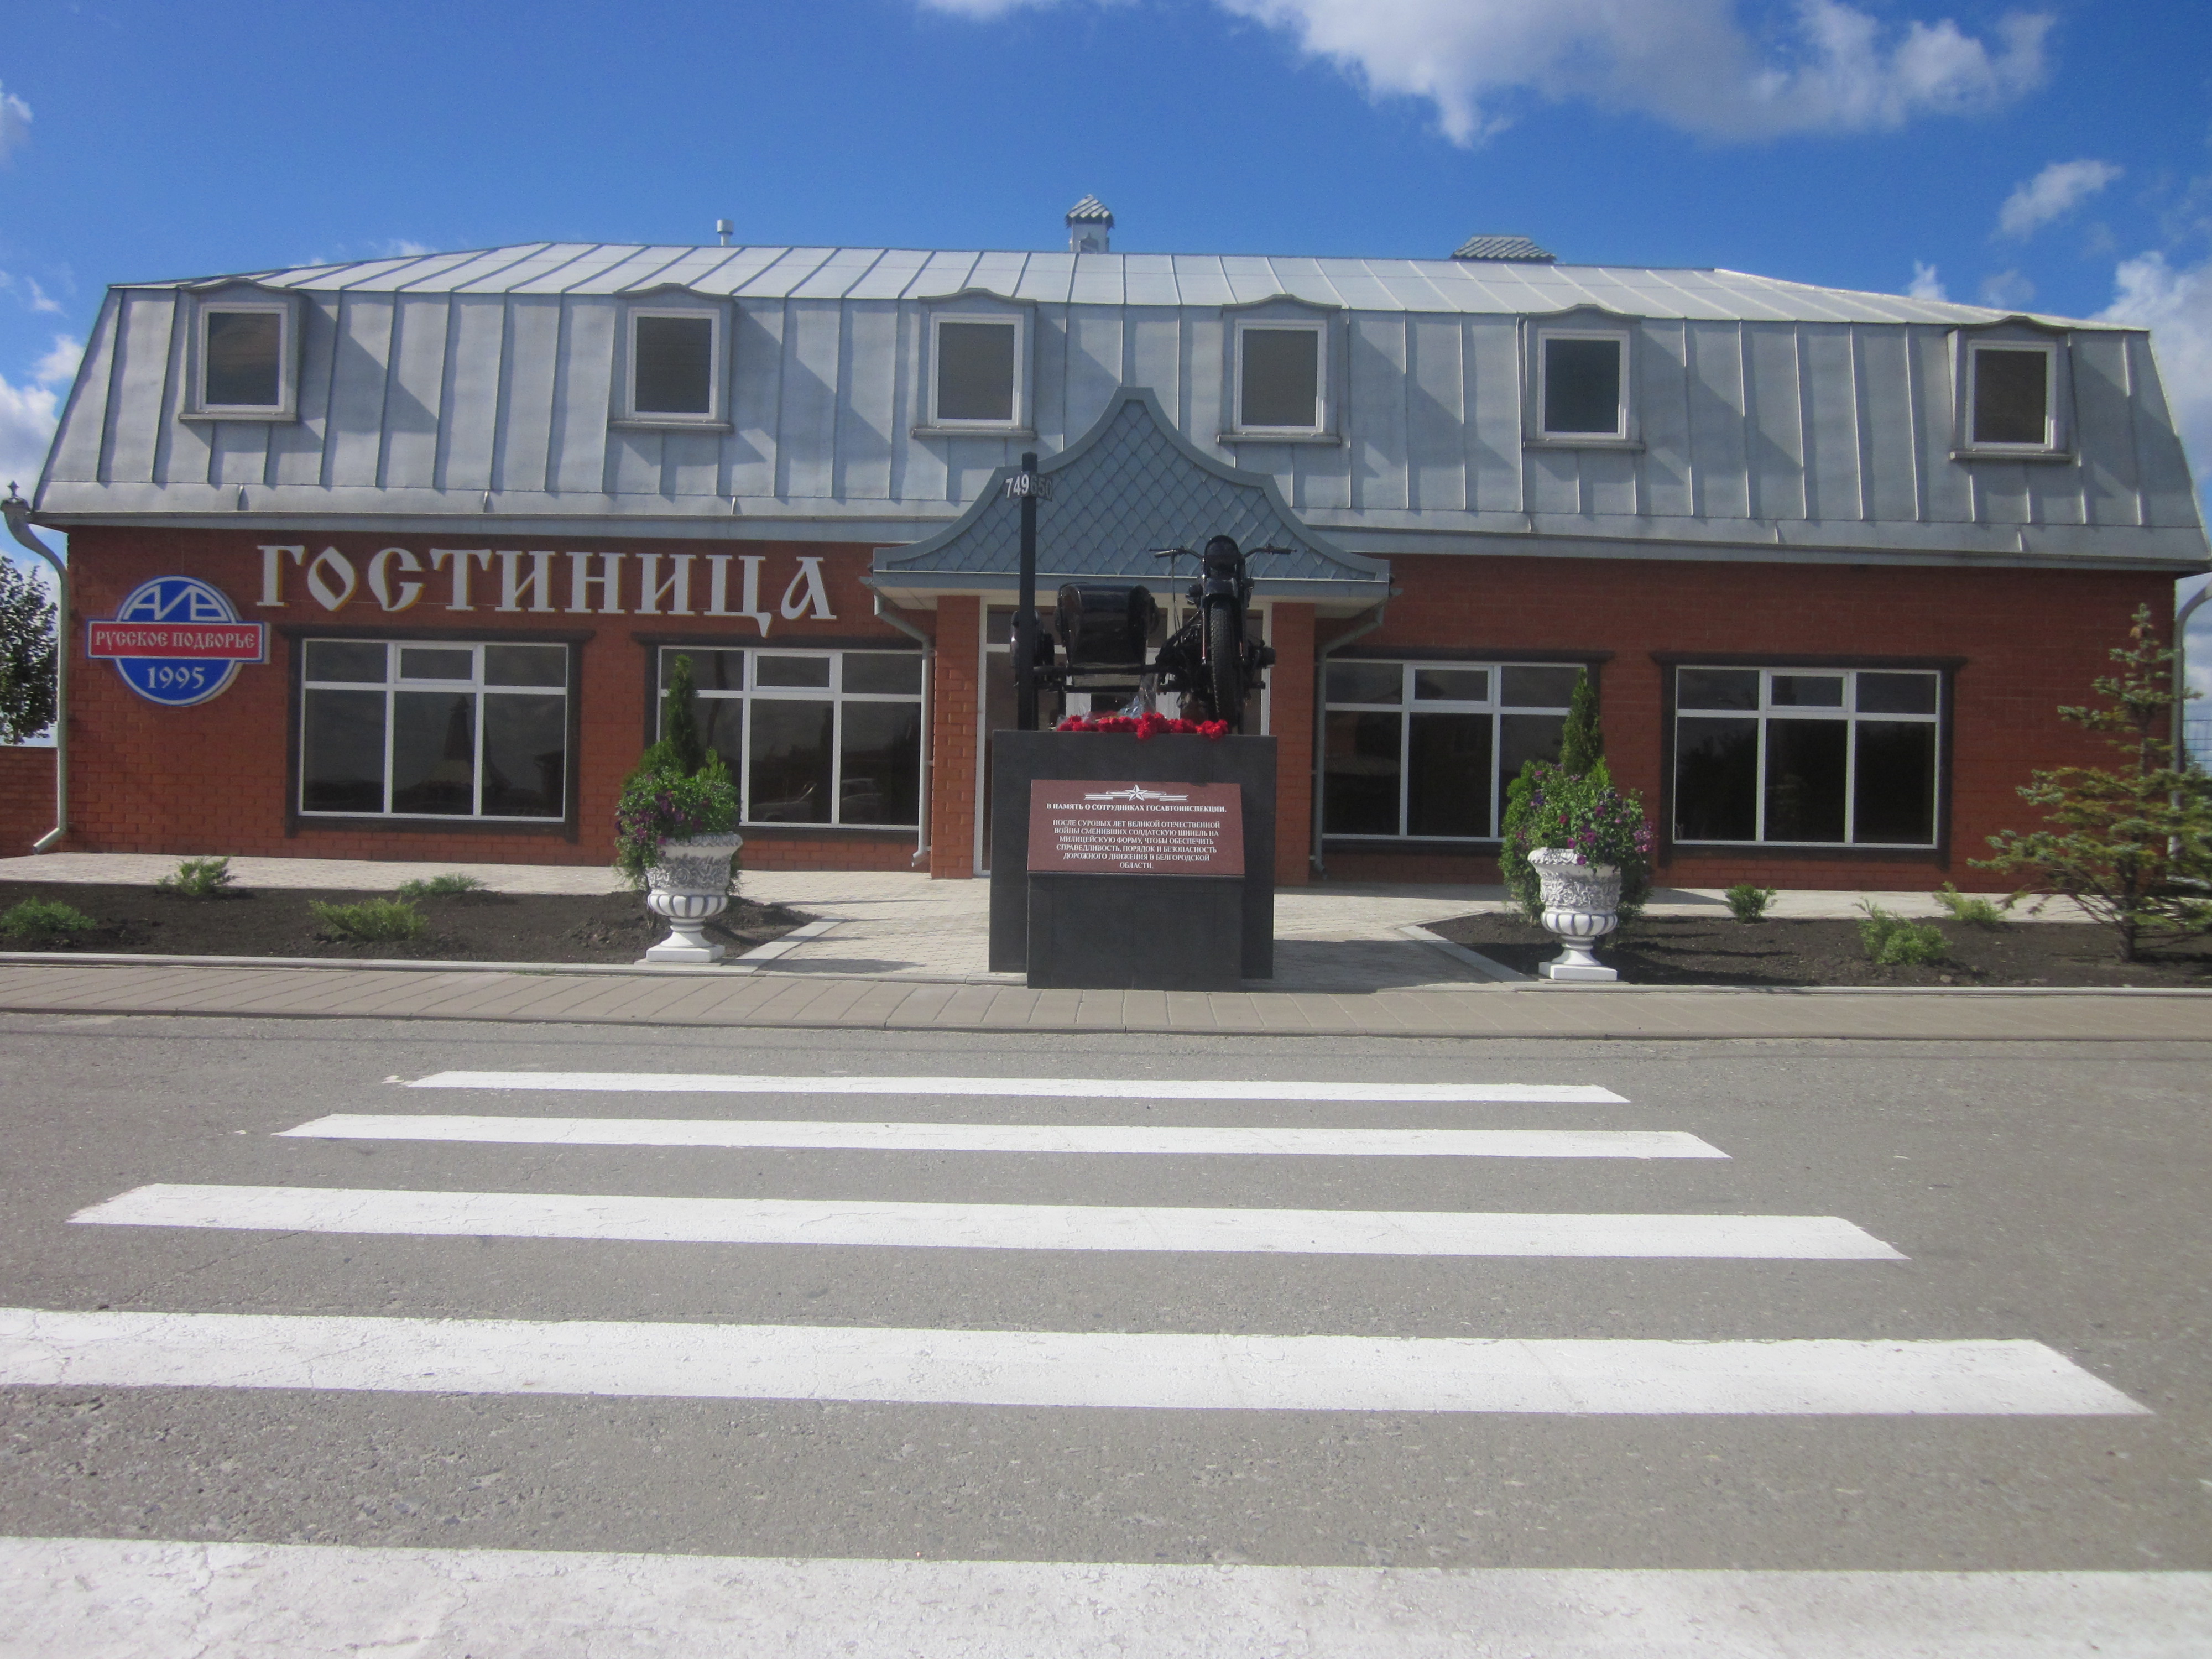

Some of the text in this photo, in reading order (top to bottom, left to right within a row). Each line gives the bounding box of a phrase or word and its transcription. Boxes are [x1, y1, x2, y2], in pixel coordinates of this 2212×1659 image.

[1005, 474, 1029, 498] 749
[256, 545, 838, 638] ГОСТИНИЦА
[95, 631, 255, 650] РУССКОЕ ПОДВОРЬЕ
[147, 666, 205, 689] 1995
[1146, 805, 1227, 813] ГОСАВТОИНСПЕКЦИИ.
[1128, 820, 1160, 828] ВЕЛИКОЙ
[1060, 835, 1115, 843] МИЛИЦЕЙСКУЮ
[1117, 836, 1143, 844] ФОРМУ,
[1156, 854, 1210, 862] БЕЛГОРОДСКОЙ
